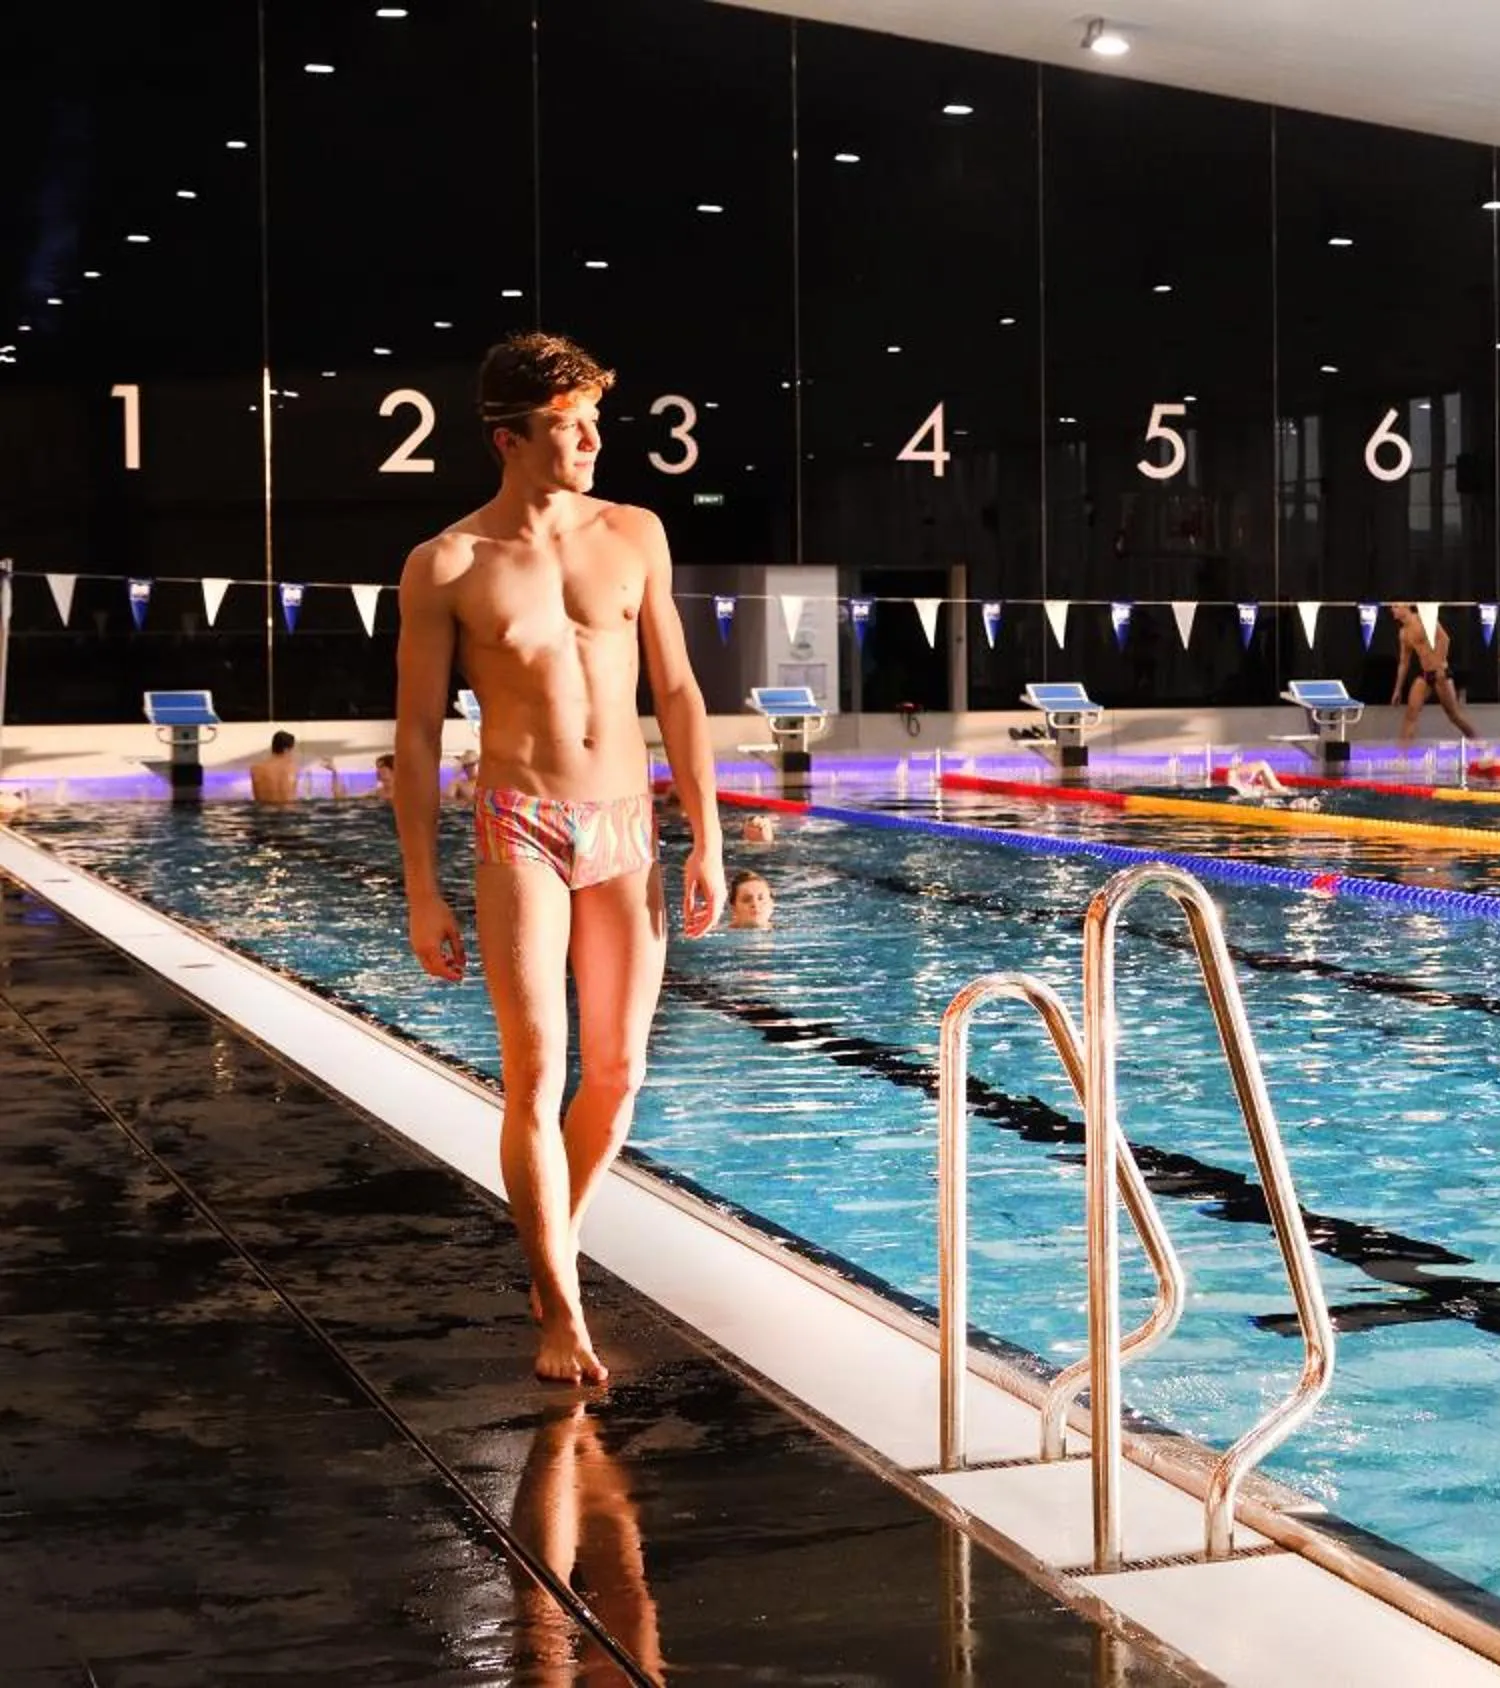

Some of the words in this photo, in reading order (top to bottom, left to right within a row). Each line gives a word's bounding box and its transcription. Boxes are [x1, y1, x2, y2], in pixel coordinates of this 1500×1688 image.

[111, 384, 140, 469] 1
[378, 388, 436, 473] 2
[648, 395, 699, 475] 3
[897, 401, 951, 478] 4
[1136, 403, 1188, 480] 5
[1364, 408, 1413, 482] 6
